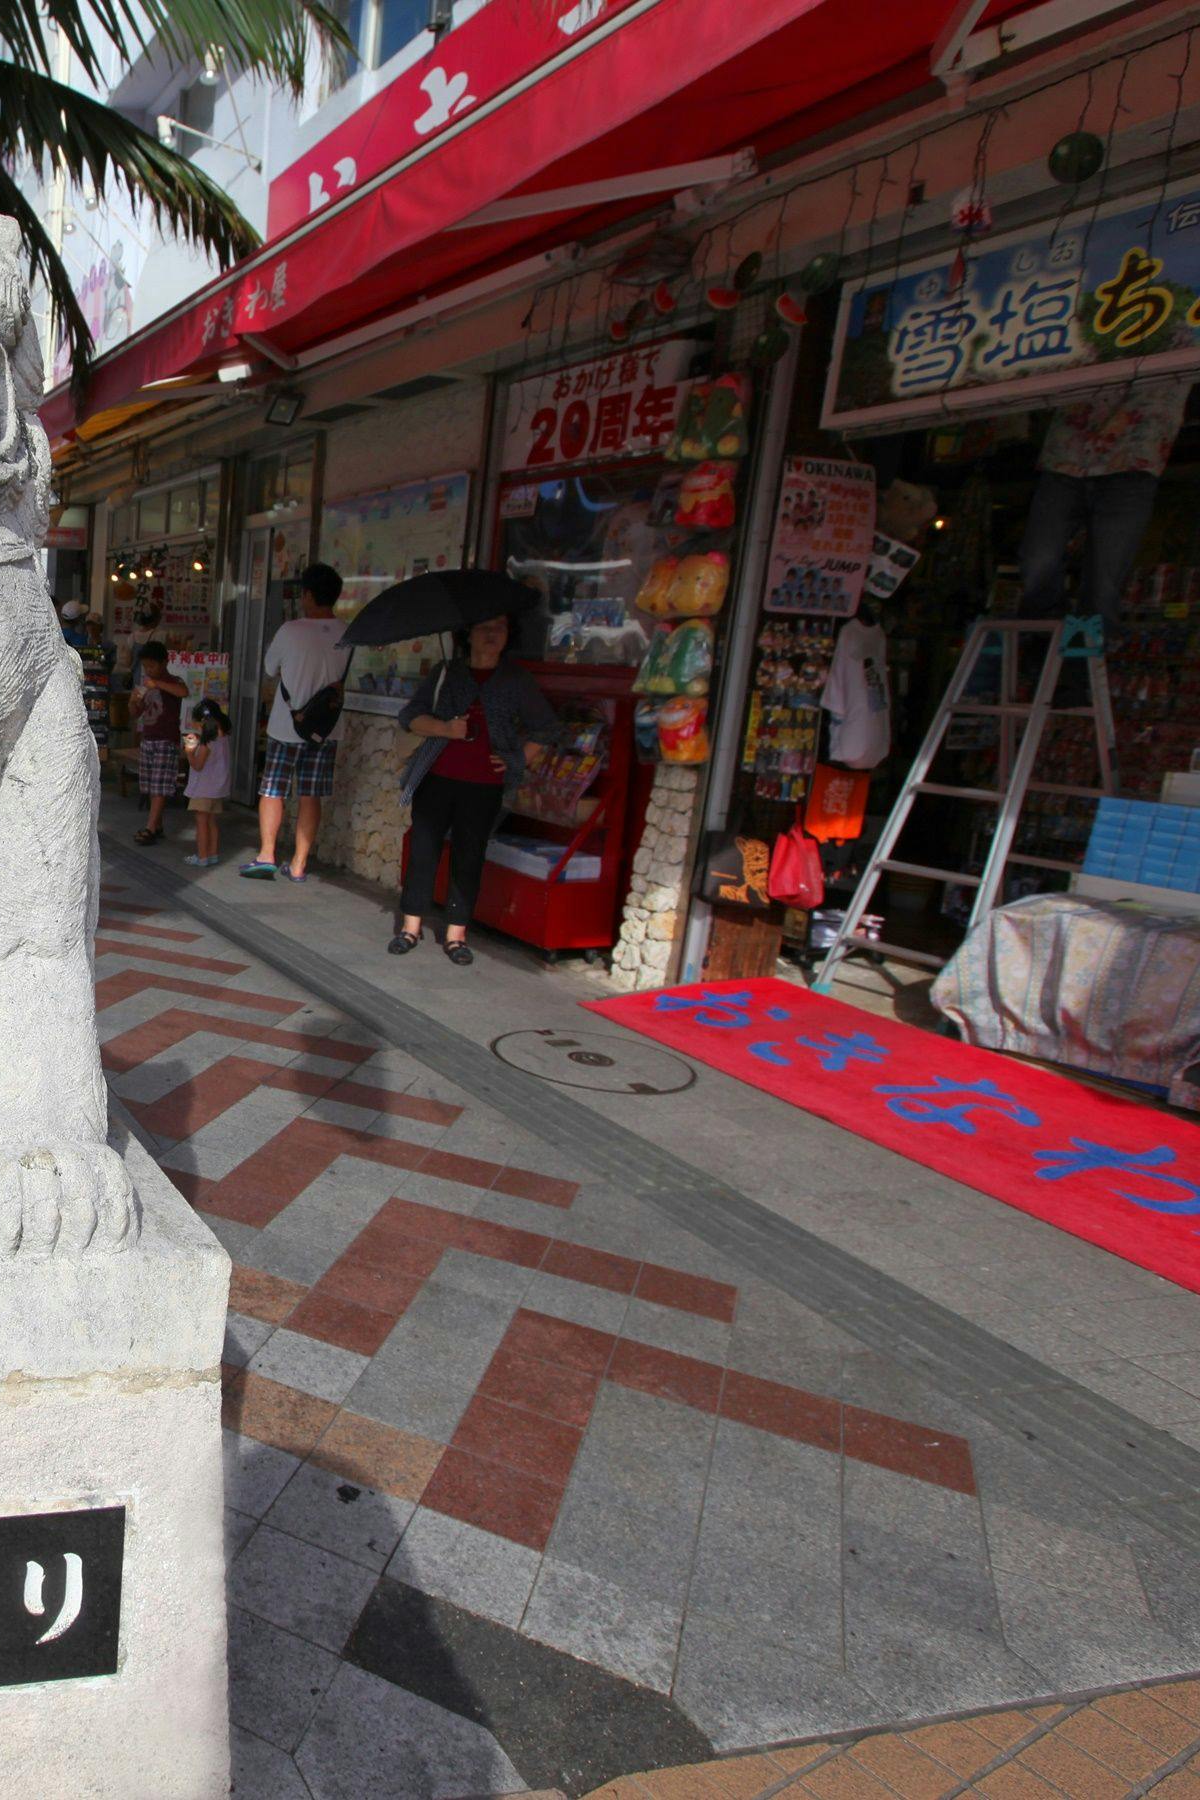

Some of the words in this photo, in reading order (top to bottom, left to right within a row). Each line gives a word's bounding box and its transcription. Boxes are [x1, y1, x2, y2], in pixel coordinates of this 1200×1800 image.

[553, 350, 661, 401] おかげ様で
[527, 384, 677, 465] 20周年
[804, 461, 875, 482] OKINAWA
[821, 558, 862, 574] JUMP
[654, 990, 1200, 1216] おきなわ
